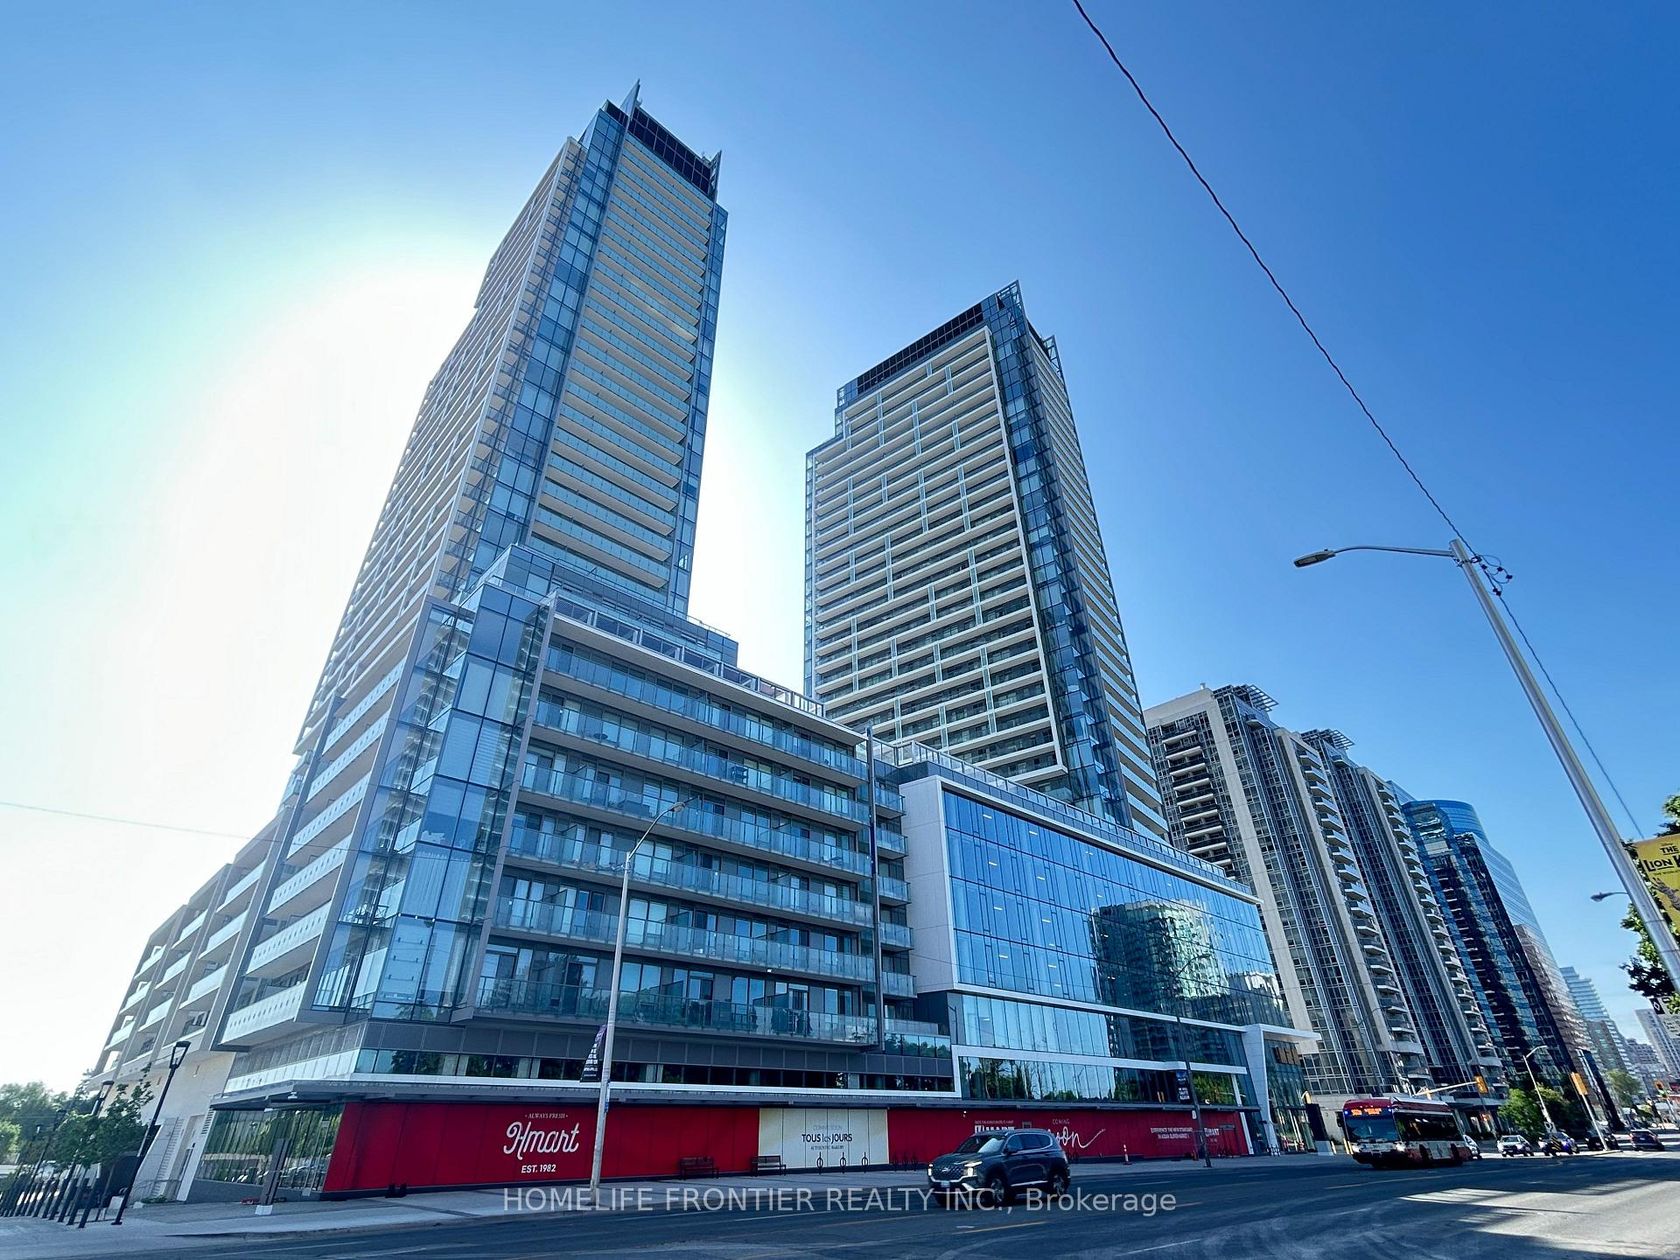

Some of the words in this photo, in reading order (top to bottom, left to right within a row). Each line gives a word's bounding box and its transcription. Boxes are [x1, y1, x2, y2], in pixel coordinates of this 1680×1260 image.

[1659, 845, 1679, 853] THE
[1643, 859, 1673, 872] LION
[801, 1133, 821, 1142] TOUS
[831, 1133, 853, 1144] JOURS
[521, 1165, 538, 1173] EST.
[540, 1164, 556, 1173] 1982
